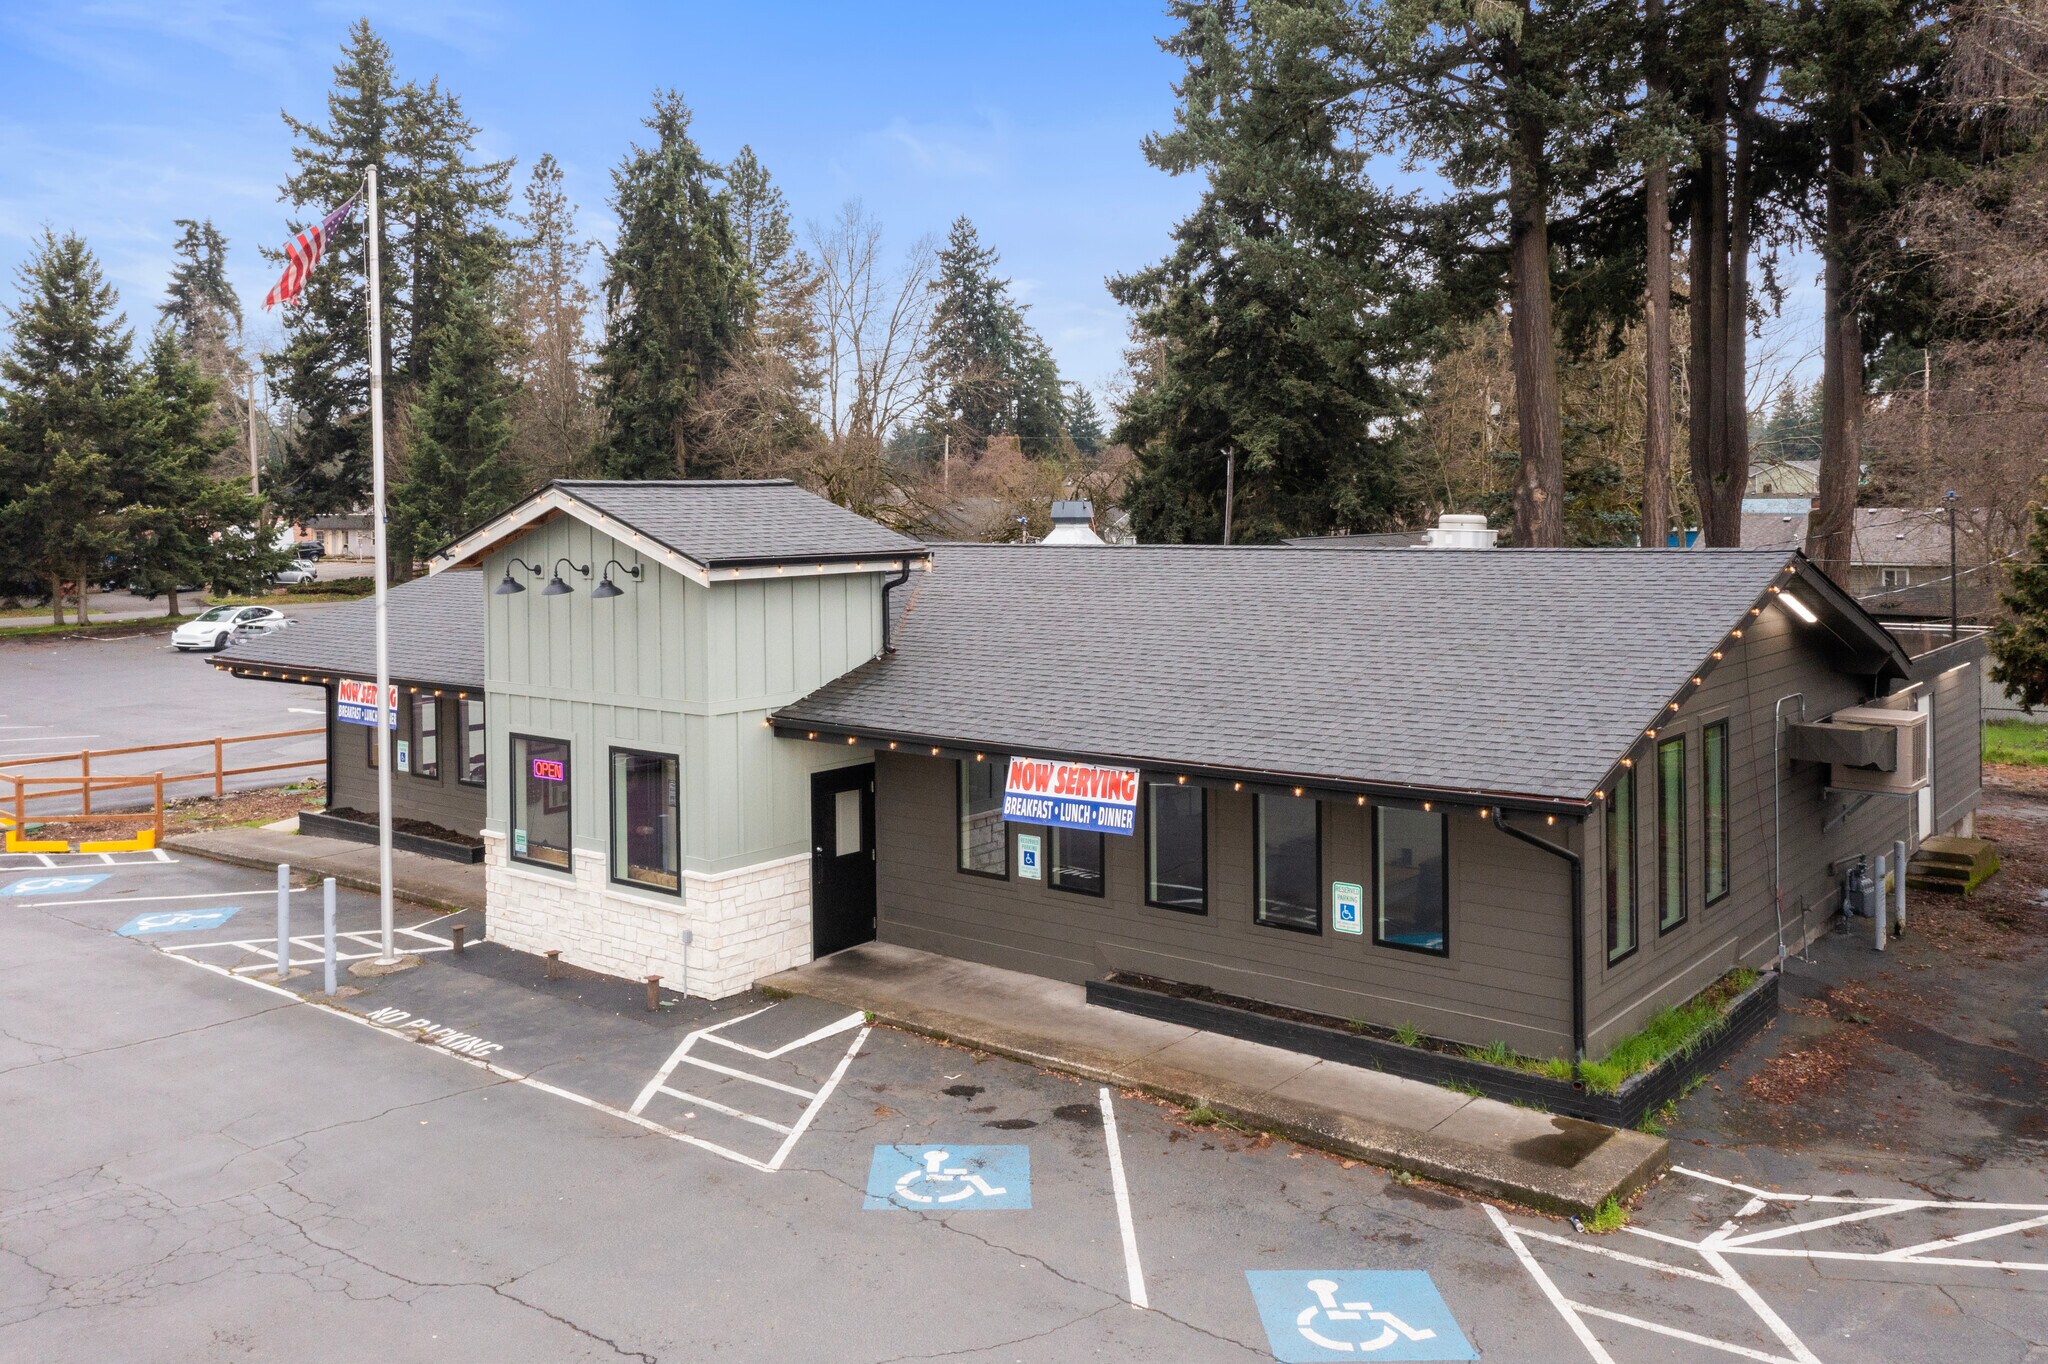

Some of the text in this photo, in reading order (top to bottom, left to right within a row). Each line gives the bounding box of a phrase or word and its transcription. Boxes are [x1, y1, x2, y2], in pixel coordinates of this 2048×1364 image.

[340, 681, 396, 708] NOW SERG
[536, 761, 562, 778] OPEN
[1009, 761, 1135, 801] NOW SERVING
[1004, 796, 1133, 829] BREAKFAST LUNCH DINNER
[1335, 886, 1360, 895] RESERVED
[1337, 894, 1358, 903] PARKING
[366, 1006, 411, 1024] NO
